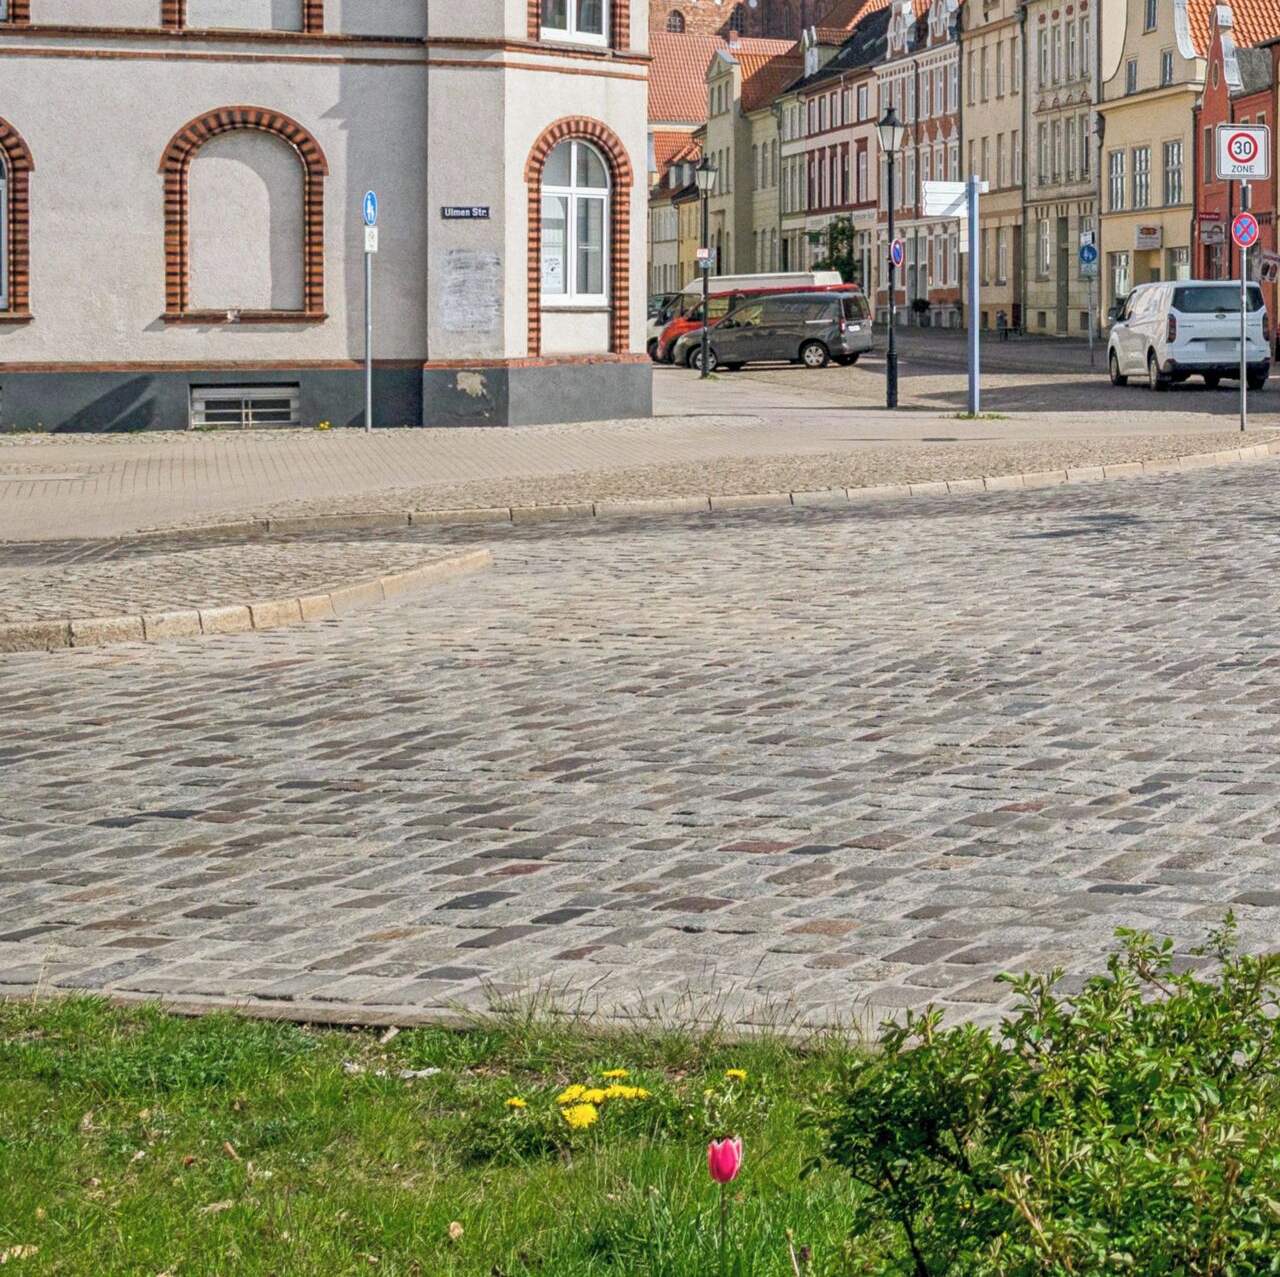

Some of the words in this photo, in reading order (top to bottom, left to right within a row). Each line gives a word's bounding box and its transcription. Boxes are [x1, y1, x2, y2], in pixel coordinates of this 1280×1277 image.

[1234, 141, 1252, 155] 30
[1231, 165, 1255, 173] ZONE
[444, 207, 470, 217] Ulmen
